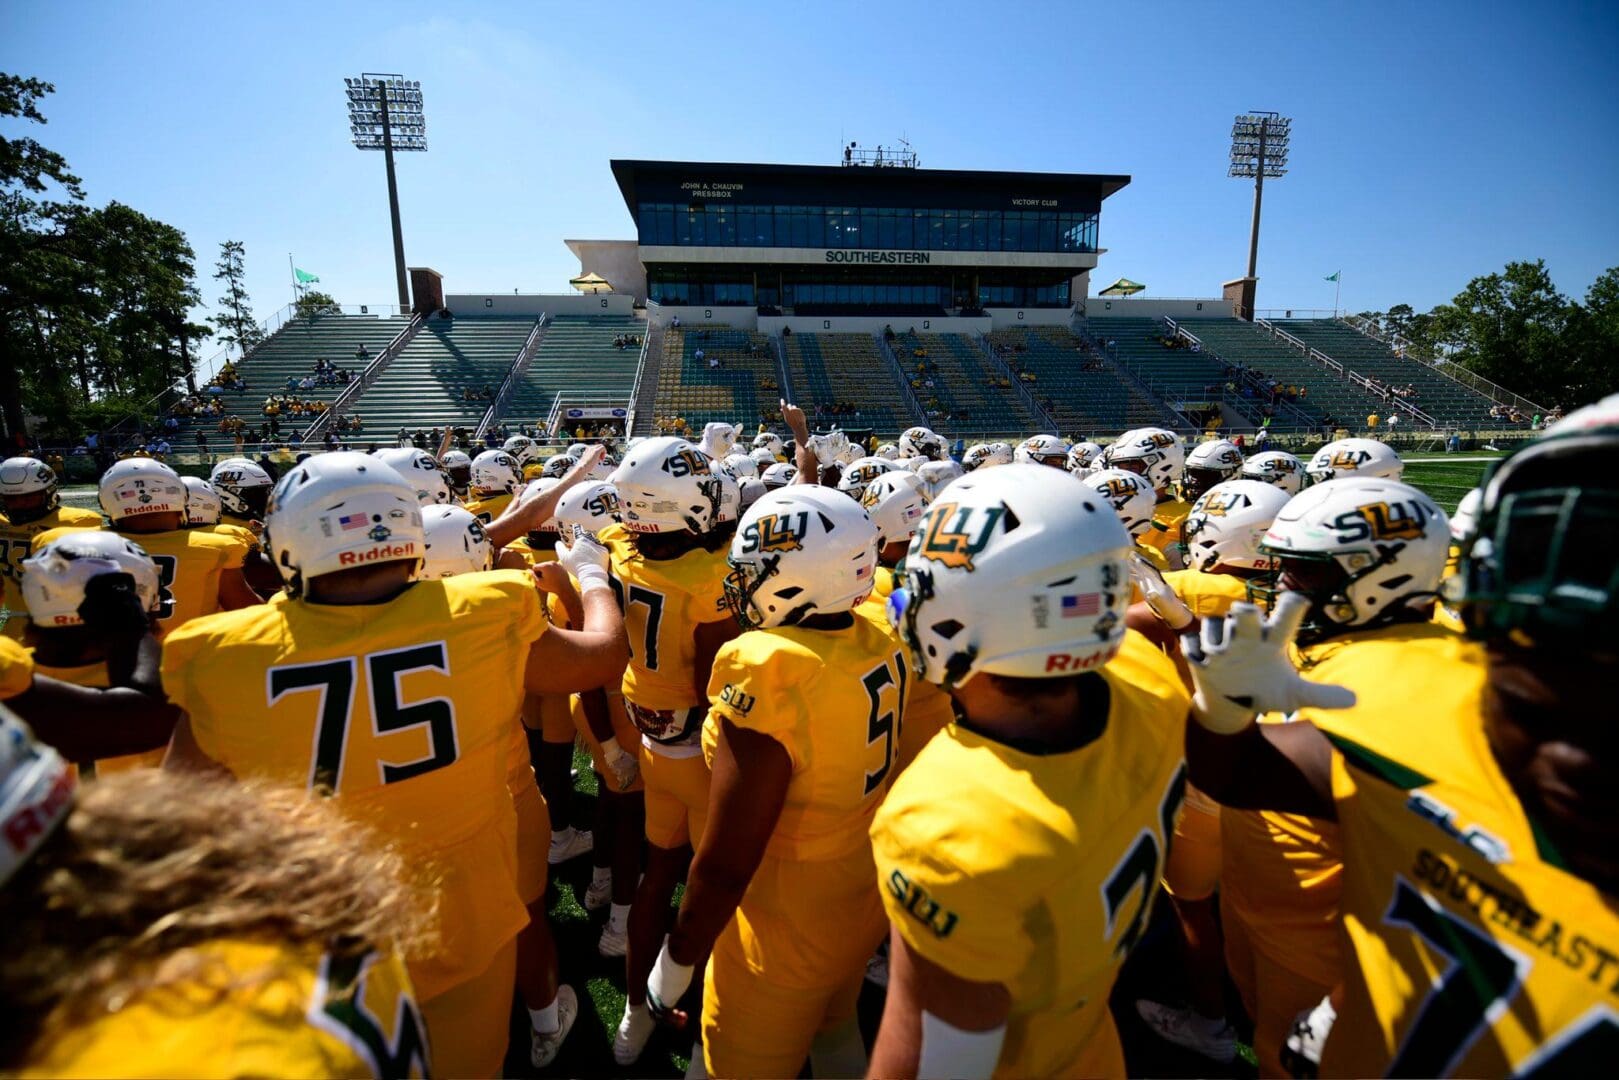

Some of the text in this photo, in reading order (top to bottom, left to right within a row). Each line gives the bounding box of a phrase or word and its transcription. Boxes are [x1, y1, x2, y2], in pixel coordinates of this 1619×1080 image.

[826, 250, 930, 264] SOUTHEASTERN
[1141, 433, 1175, 452] SLU
[669, 450, 711, 477] SLU
[1264, 459, 1297, 473] SLU
[1317, 450, 1363, 470] SLU
[850, 465, 886, 484] SLU
[1097, 477, 1139, 499] SLU
[124, 504, 168, 514] Riddell
[742, 511, 808, 553] SLU
[1335, 500, 1427, 544] SLU
[338, 543, 415, 565] Riddell
[720, 683, 756, 718] SLU
[267, 640, 460, 797] 75
[886, 869, 959, 939] SLU
[1412, 848, 1619, 996] SOUTHEAST
